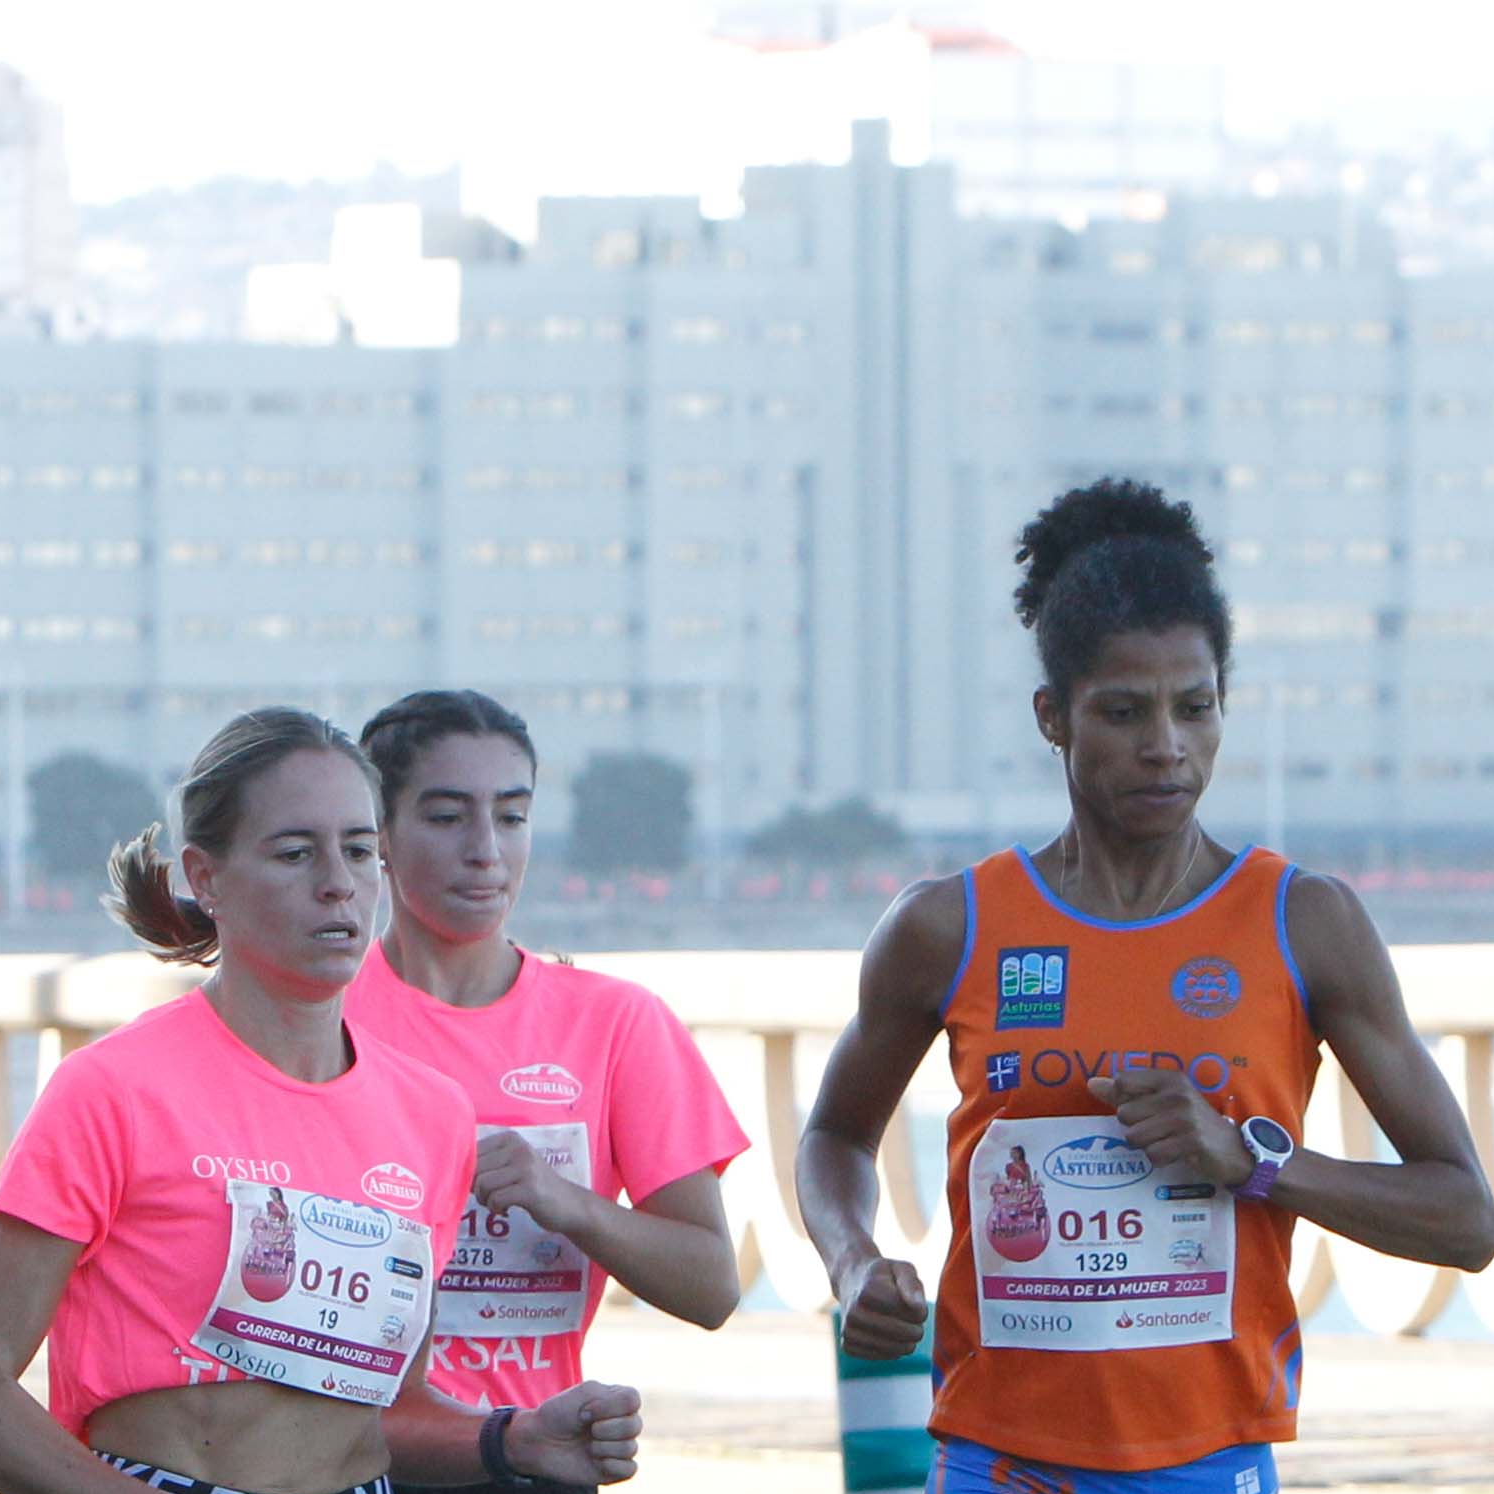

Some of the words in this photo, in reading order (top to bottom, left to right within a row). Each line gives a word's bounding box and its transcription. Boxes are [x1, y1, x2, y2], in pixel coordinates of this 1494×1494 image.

[1000, 1001, 1062, 1014] Asturias
[508, 1074, 576, 1097] ASTURIANA
[192, 1154, 291, 1184] OYSHO
[1052, 1155, 1146, 1177] ASTURIANA
[368, 1176, 420, 1200] ASTURIANA
[306, 1202, 386, 1241] ASTURIANA
[461, 1208, 511, 1237] 16
[1058, 1208, 1144, 1241] 016
[1075, 1251, 1128, 1273] 1329
[300, 1259, 372, 1303] 016
[441, 1276, 462, 1287] DE
[463, 1276, 481, 1287] LA
[483, 1277, 530, 1288] MUJER
[1006, 1281, 1071, 1296] CARRERA
[1073, 1282, 1095, 1297] DE
[1097, 1282, 1120, 1297] LA
[1122, 1280, 1169, 1296] MUJER
[1174, 1278, 1208, 1292] 2023
[317, 1308, 339, 1330] 19
[497, 1305, 569, 1319] Santander
[1001, 1313, 1073, 1333] OYSHO
[1135, 1310, 1212, 1328] Santander
[236, 1320, 296, 1347] CARRERA
[297, 1335, 317, 1352] DE
[317, 1340, 333, 1354] LA
[333, 1344, 373, 1366] MUJER
[372, 1353, 394, 1369] 2023
[215, 1342, 287, 1380] OYSHO
